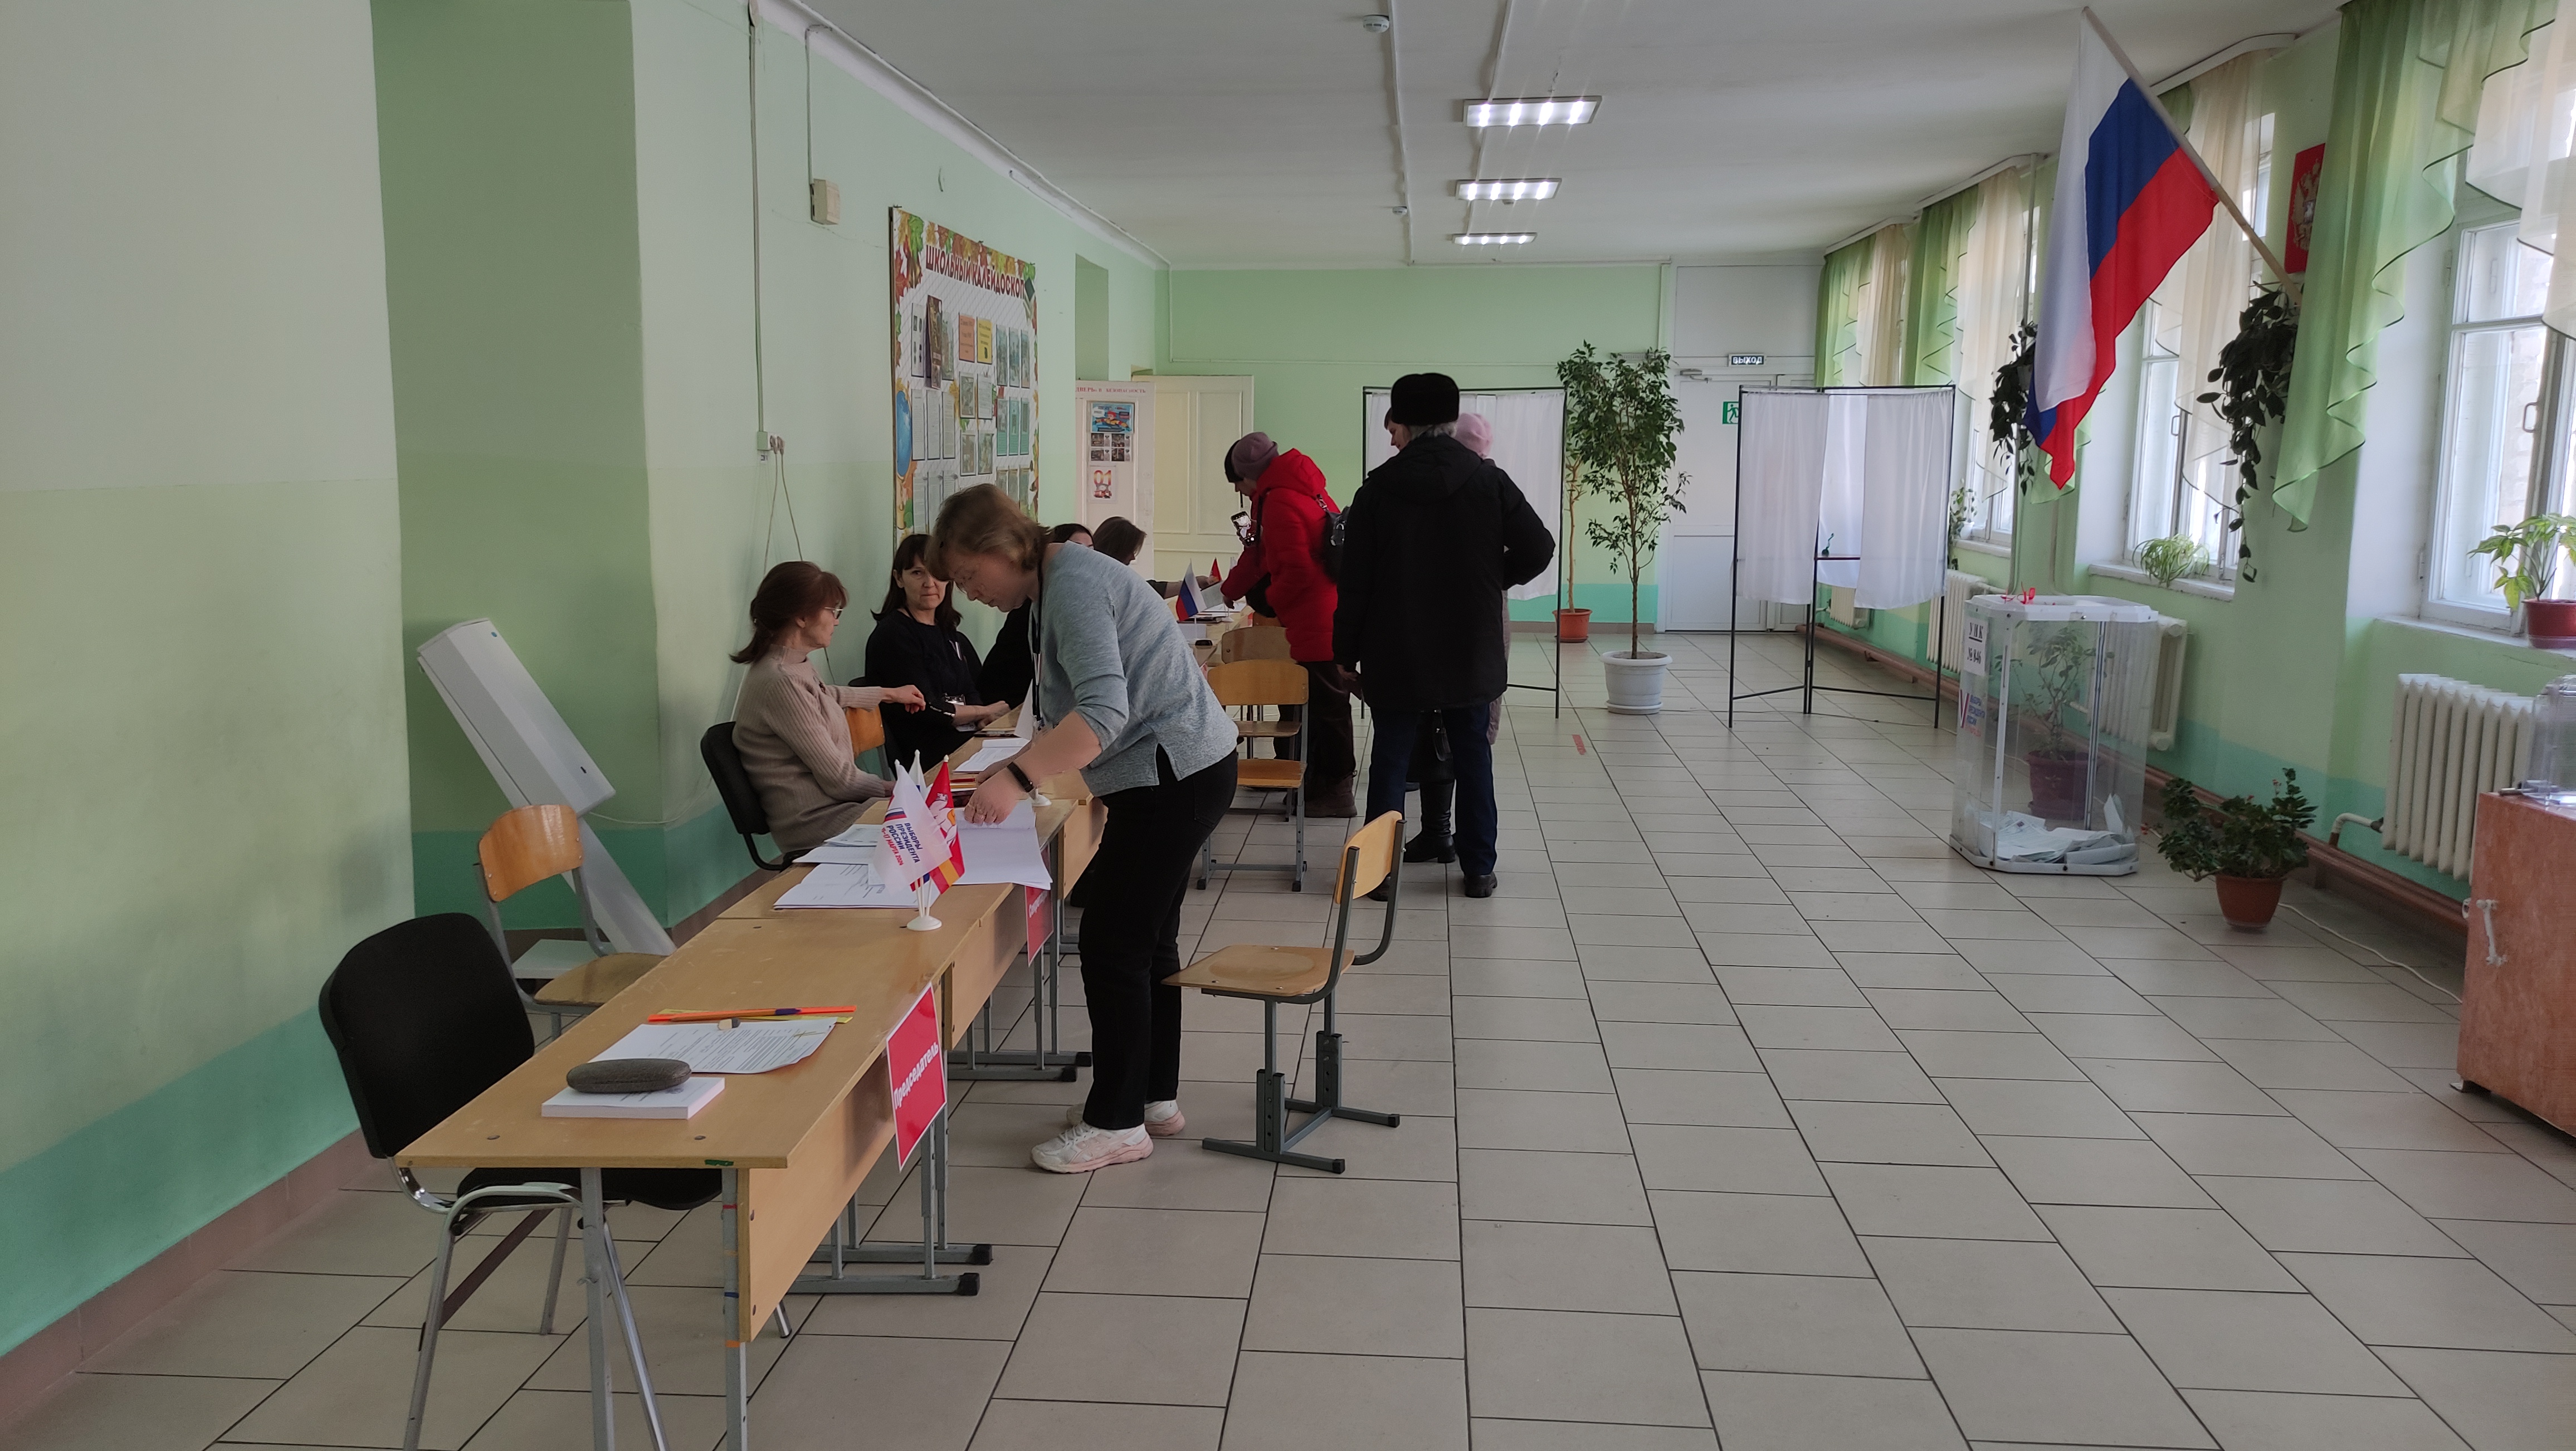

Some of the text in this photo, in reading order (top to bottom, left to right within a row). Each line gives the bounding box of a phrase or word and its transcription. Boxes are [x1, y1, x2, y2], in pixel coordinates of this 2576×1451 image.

[925, 244, 1024, 300] ШКОЛЬНЫЙ КАЛЕЙДОСКОП
[1094, 470, 1111, 485] 01
[1969, 622, 1984, 639] УИК
[886, 825, 905, 850] РОССИИ
[895, 824, 920, 863] ПРЕЗИДЕНТА
[904, 822, 923, 850] ВЫБОРЫ
[886, 838, 899, 855] МАРТА
[895, 855, 904, 866] 2024
[893, 1041, 939, 1110] Председатель
